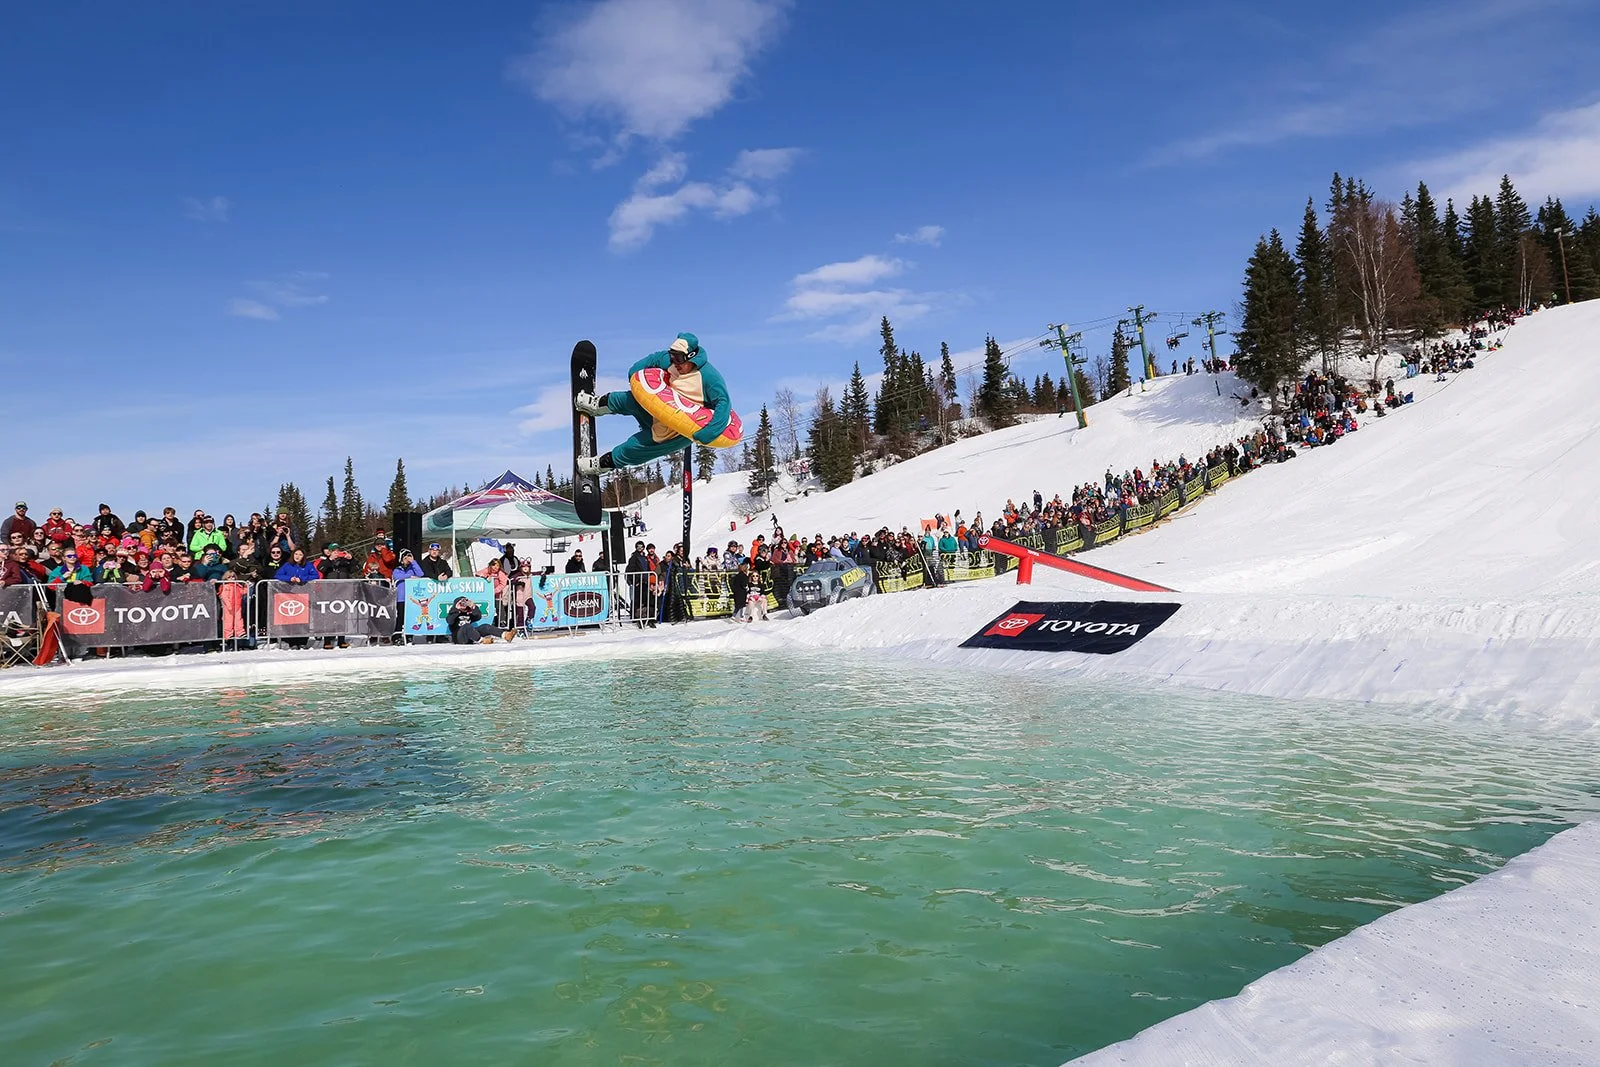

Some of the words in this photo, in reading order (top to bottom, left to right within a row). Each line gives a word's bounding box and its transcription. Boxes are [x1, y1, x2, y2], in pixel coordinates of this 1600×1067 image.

[427, 582, 452, 593] SINK
[460, 581, 484, 593] SKIM
[114, 603, 210, 624] TOYOTA
[316, 599, 391, 619] TOYOTA
[1038, 619, 1141, 636] TOYOTA
